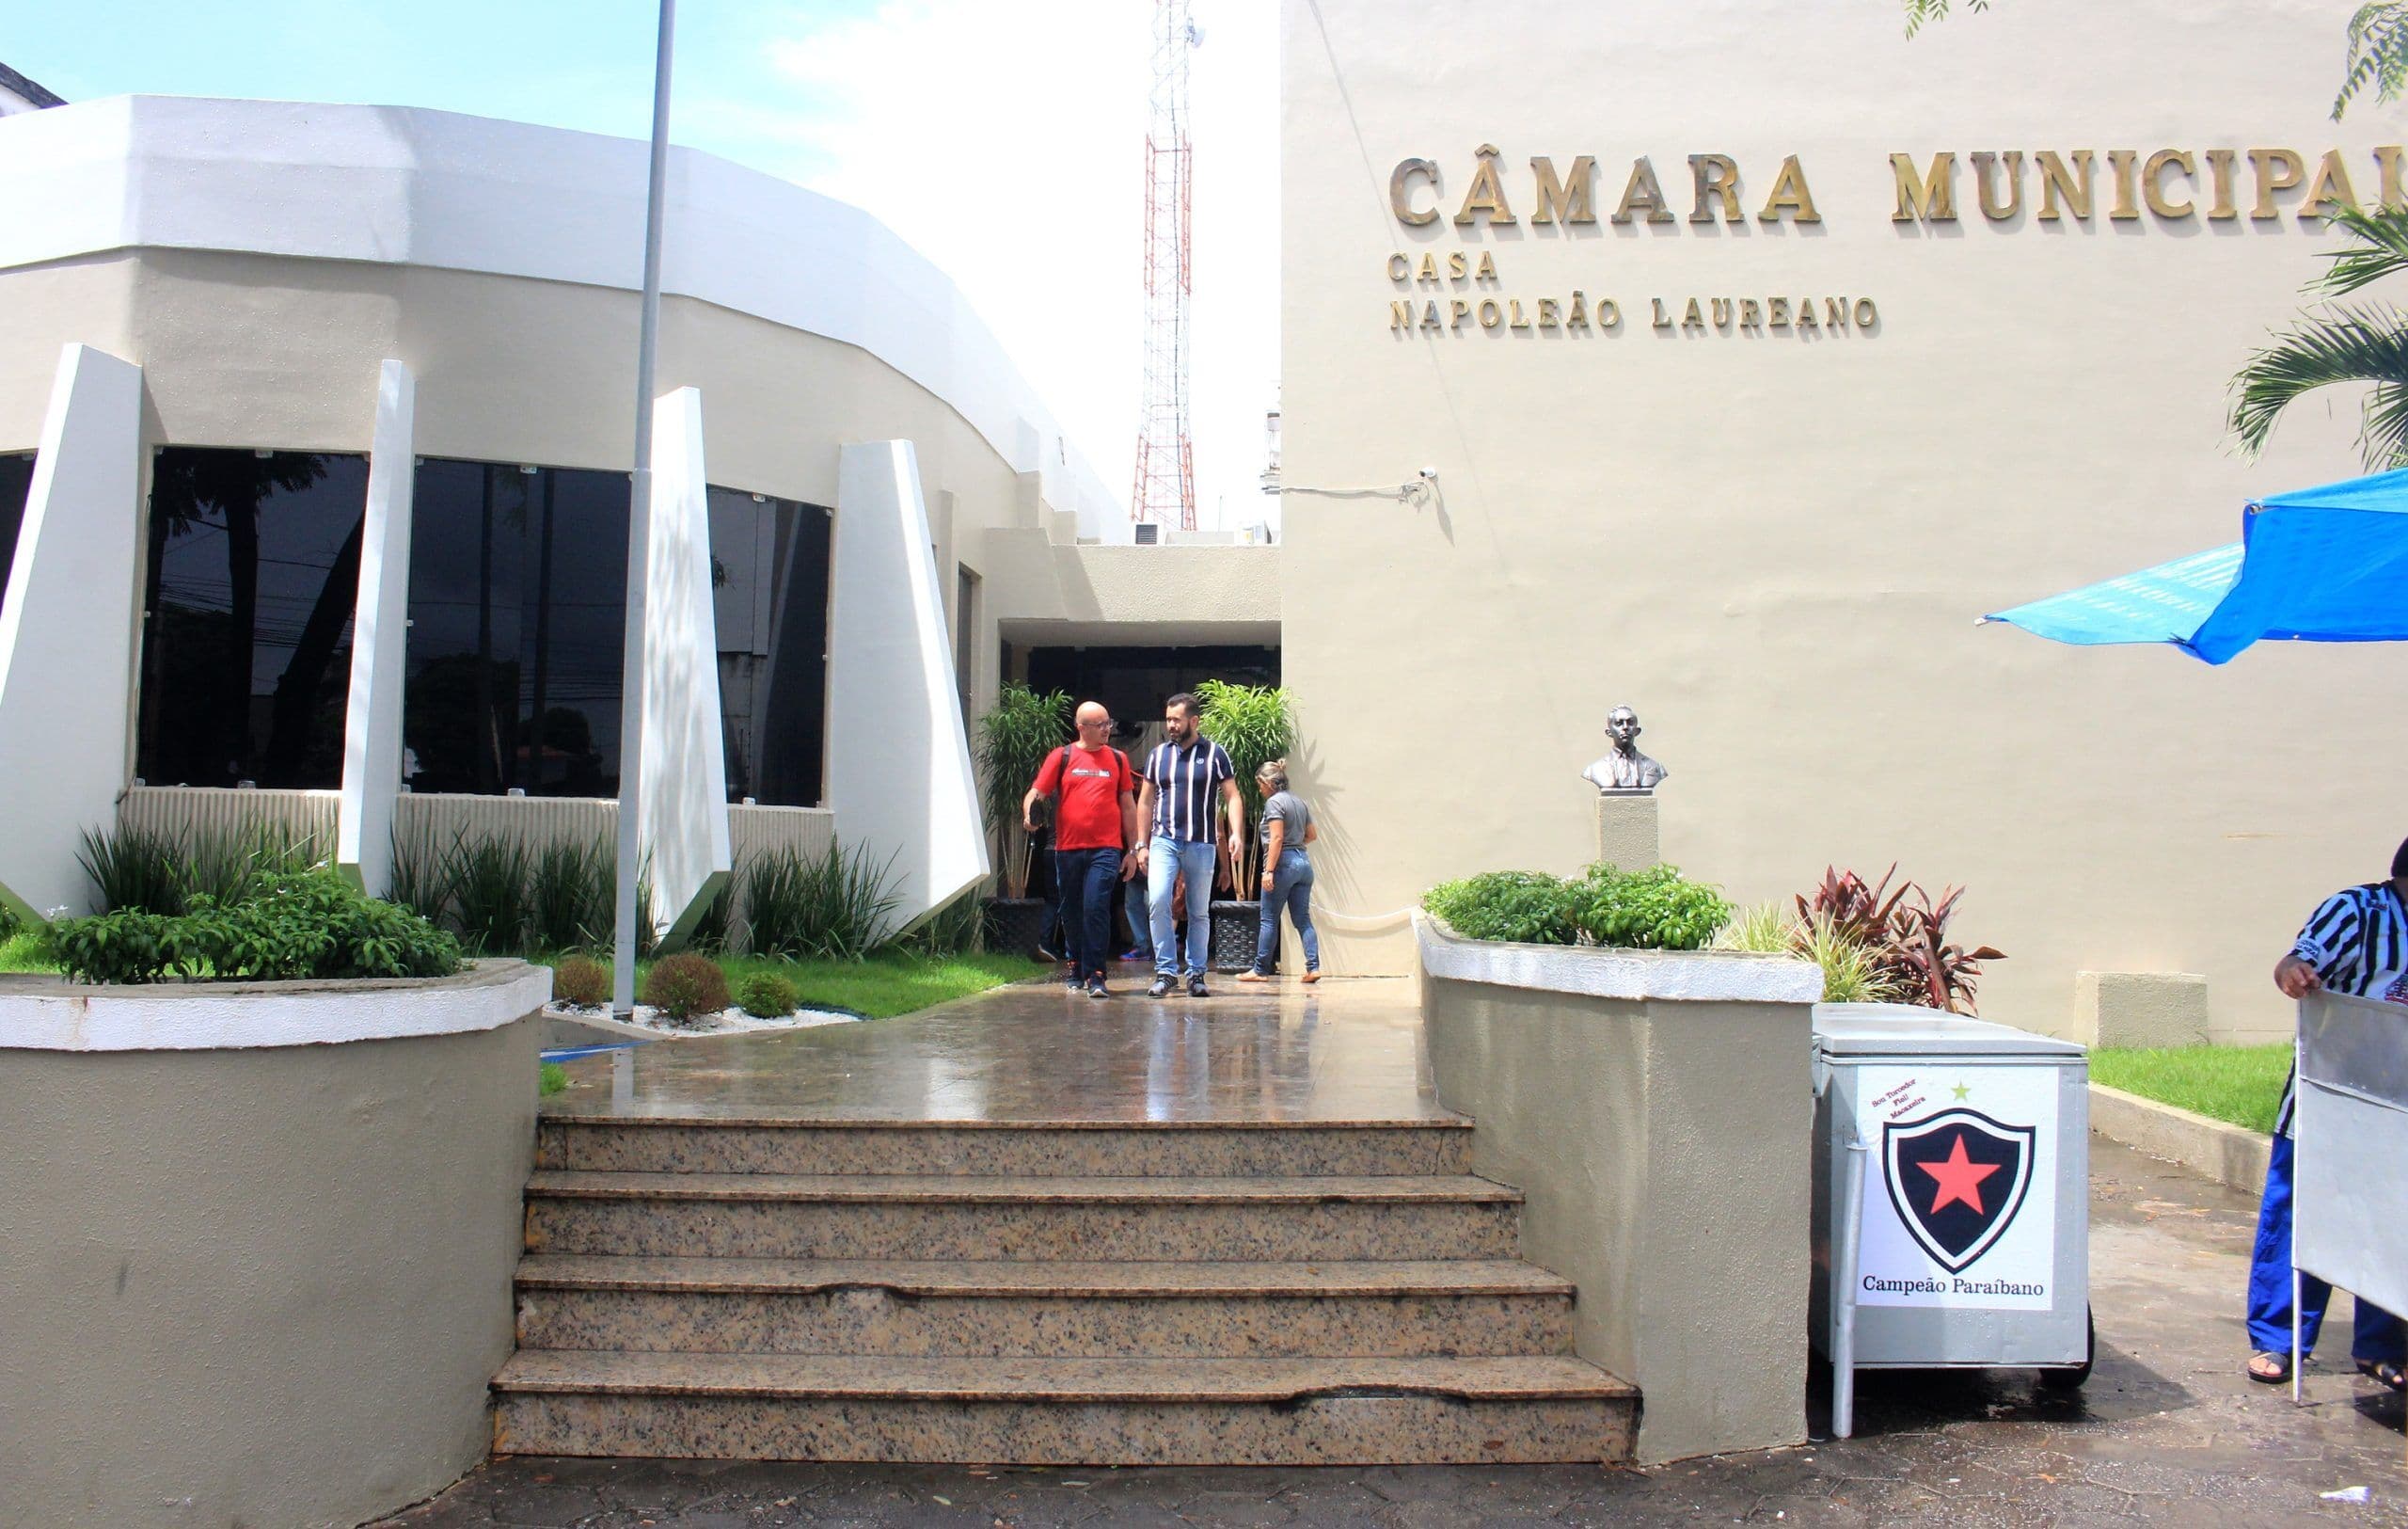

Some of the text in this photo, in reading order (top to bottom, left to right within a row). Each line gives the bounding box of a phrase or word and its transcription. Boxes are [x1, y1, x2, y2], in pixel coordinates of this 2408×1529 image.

[1389, 143, 1822, 227] CÂMARA
[1386, 250, 1498, 282] CASA
[1390, 291, 1877, 329] NAPOLEÃO LAUREANO
[1862, 1275, 1946, 1296] Campeão
